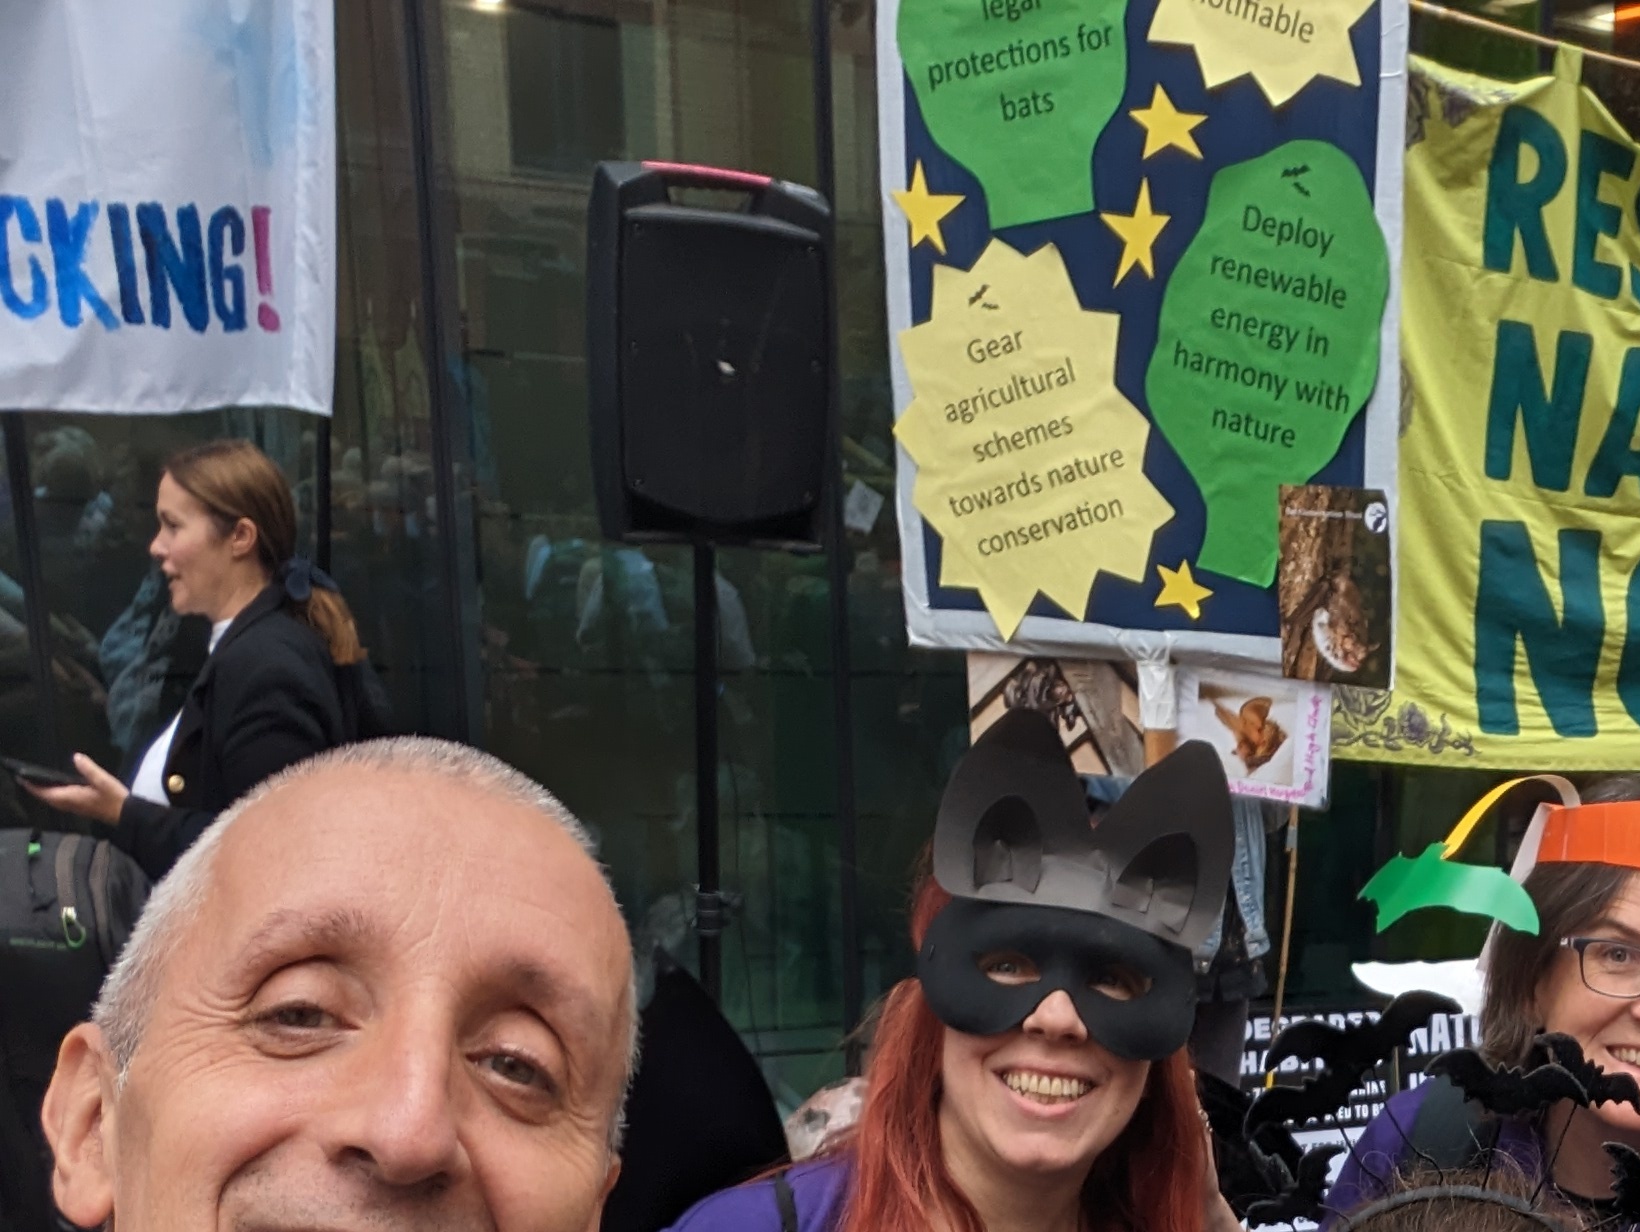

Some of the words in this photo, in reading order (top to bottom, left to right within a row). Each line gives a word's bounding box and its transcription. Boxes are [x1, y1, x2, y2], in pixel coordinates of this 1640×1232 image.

[1200, 0, 1314, 43] tifiable
[928, 36, 1071, 93] protections
[1076, 23, 1113, 53] for
[1000, 91, 1055, 122] bats
[1242, 204, 1335, 259] Deploy
[0, 193, 282, 334] CKING!
[1210, 254, 1348, 309] renewable
[967, 330, 1023, 364] Gear
[1210, 306, 1300, 353] energy
[1306, 326, 1330, 357] in
[944, 355, 1077, 425] agricultural
[1173, 339, 1289, 402] harmony
[1295, 379, 1351, 415] with
[972, 414, 1075, 463] schemes
[1212, 406, 1297, 449] nature
[948, 471, 1043, 518] towards
[1049, 449, 1126, 489] nature
[977, 497, 1125, 557] conservation
